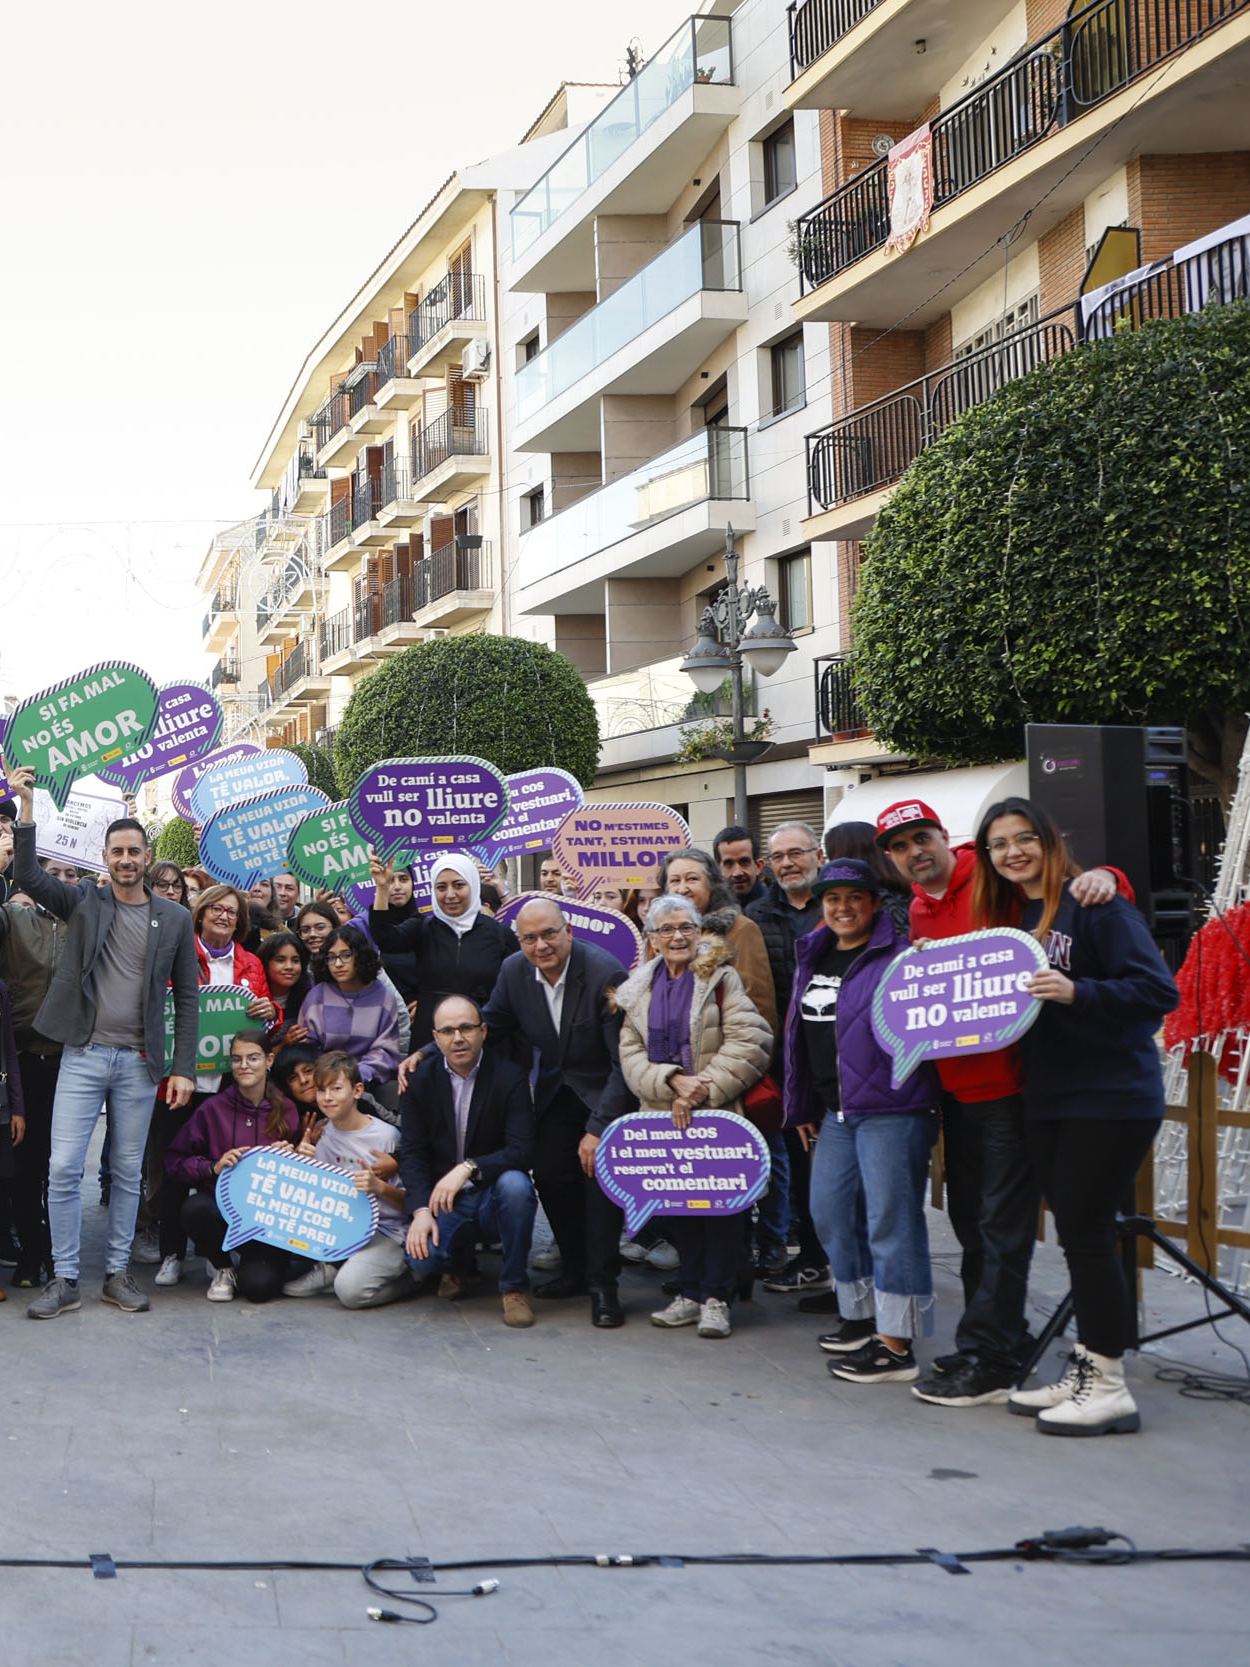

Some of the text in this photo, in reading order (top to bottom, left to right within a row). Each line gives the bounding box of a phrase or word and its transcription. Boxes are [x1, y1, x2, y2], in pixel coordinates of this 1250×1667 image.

[39, 671, 126, 721] SI FA MAL
[165, 693, 191, 709] casa
[22, 718, 74, 753] NO ÉS
[48, 709, 144, 773] AMOR
[157, 726, 208, 751] valenta
[256, 758, 285, 768] VIDA
[378, 772, 481, 786] De camí a casa
[522, 781, 544, 794] cos
[210, 782, 229, 799] TÉ
[366, 788, 498, 810] vull ser lliure
[218, 818, 236, 831] LA
[237, 806, 272, 824] MEUA
[274, 794, 308, 811] VIDA
[384, 809, 422, 826] no
[428, 812, 486, 825] valenta
[518, 812, 528, 822] el
[321, 818, 337, 832] SI
[575, 820, 669, 831] NO M'ESTIMES
[56, 834, 77, 848] 25 N
[222, 827, 246, 849] TÉ
[302, 832, 350, 857] NO ÉS
[566, 836, 680, 847] TANT, ESTIMA'M
[229, 838, 277, 861] EL MEU
[244, 848, 281, 869] NO TÉ
[903, 949, 1014, 980] De camí a casa
[890, 971, 1033, 1003] vull ser lliure
[206, 998, 245, 1012] MAL
[905, 1001, 1017, 1030] no valenta
[623, 1127, 718, 1140] Del meu cos
[612, 1143, 760, 1161] i el meu vestuari,
[257, 1157, 358, 1199] LA MEUA VIDA
[614, 1162, 693, 1175] reserva't el
[642, 1174, 748, 1190] comentari
[250, 1172, 354, 1222] TÉ VALOR,
[246, 1192, 332, 1229] EL MEU COS
[254, 1210, 276, 1226] NO
[278, 1217, 298, 1234] TÉ
[297, 1224, 337, 1246] PREU
